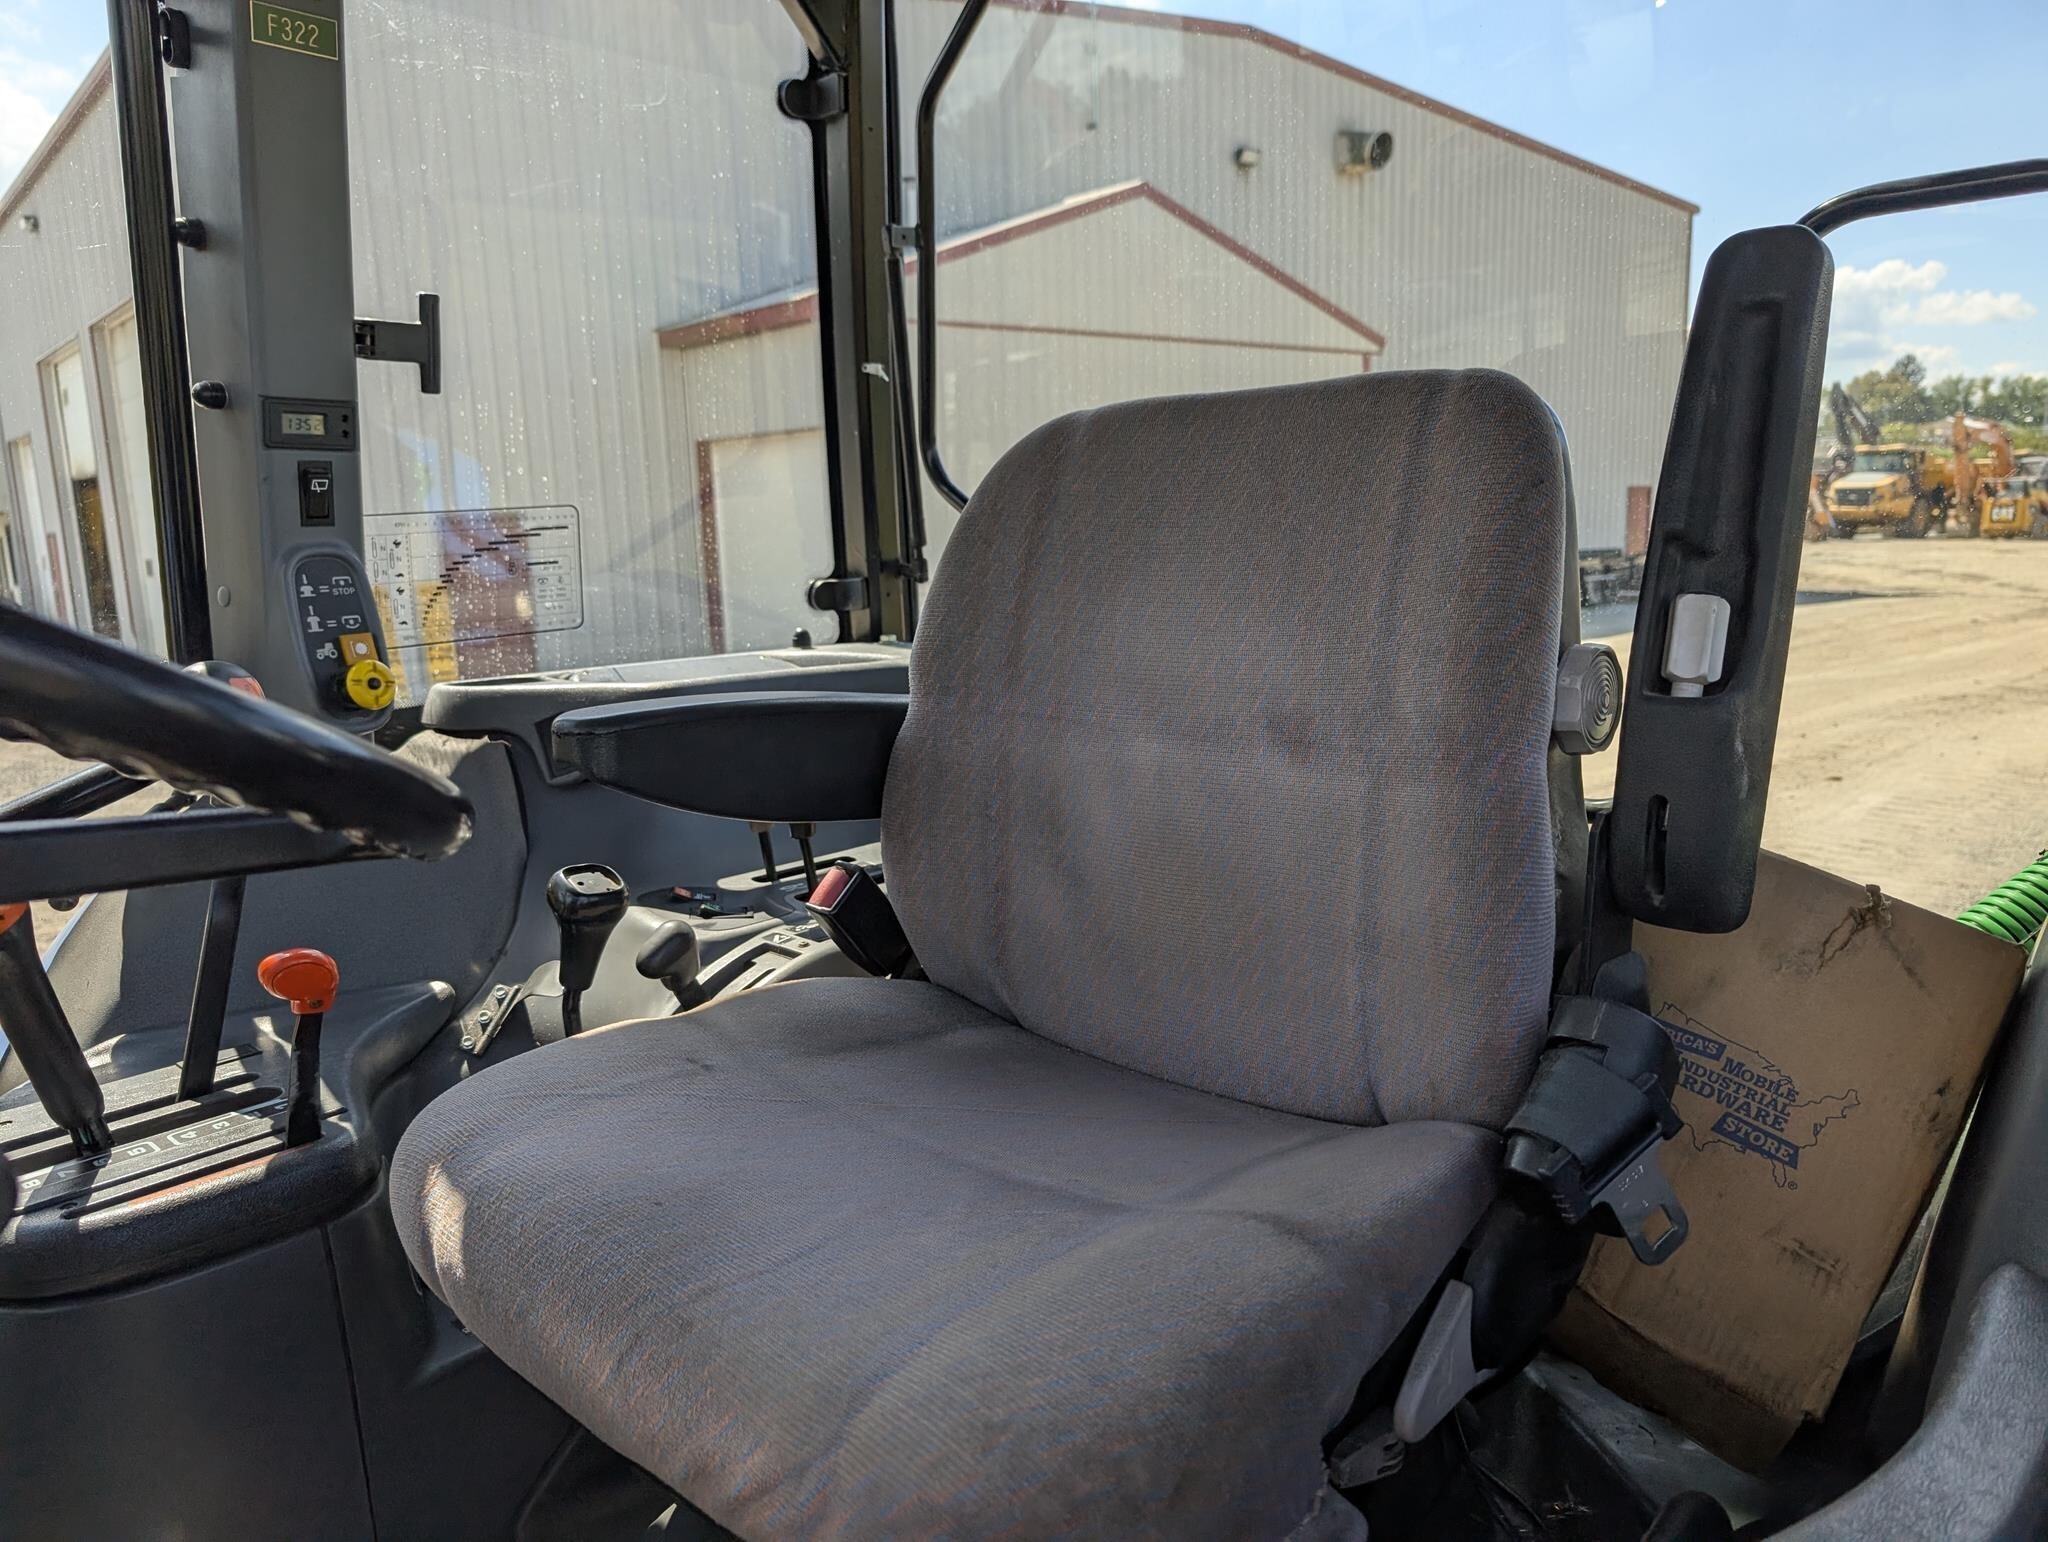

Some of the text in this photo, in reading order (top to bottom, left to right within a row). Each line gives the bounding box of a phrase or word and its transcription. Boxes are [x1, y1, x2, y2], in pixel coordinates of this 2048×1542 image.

[267, 13, 319, 48] F322
[332, 586, 356, 596] STOP
[1666, 1028, 1719, 1055] RICA'S
[1679, 1051, 1792, 1118] NDUSTRIAL
[1721, 1056, 1800, 1103] MOBILE
[1680, 1074, 1789, 1133] RDWARE
[180, 1130, 198, 1139] 4
[1723, 1117, 1796, 1161] STORE
[127, 1146, 146, 1157] 5
[22, 1179, 41, 1189] 8
[56, 1168, 77, 1178] 7
